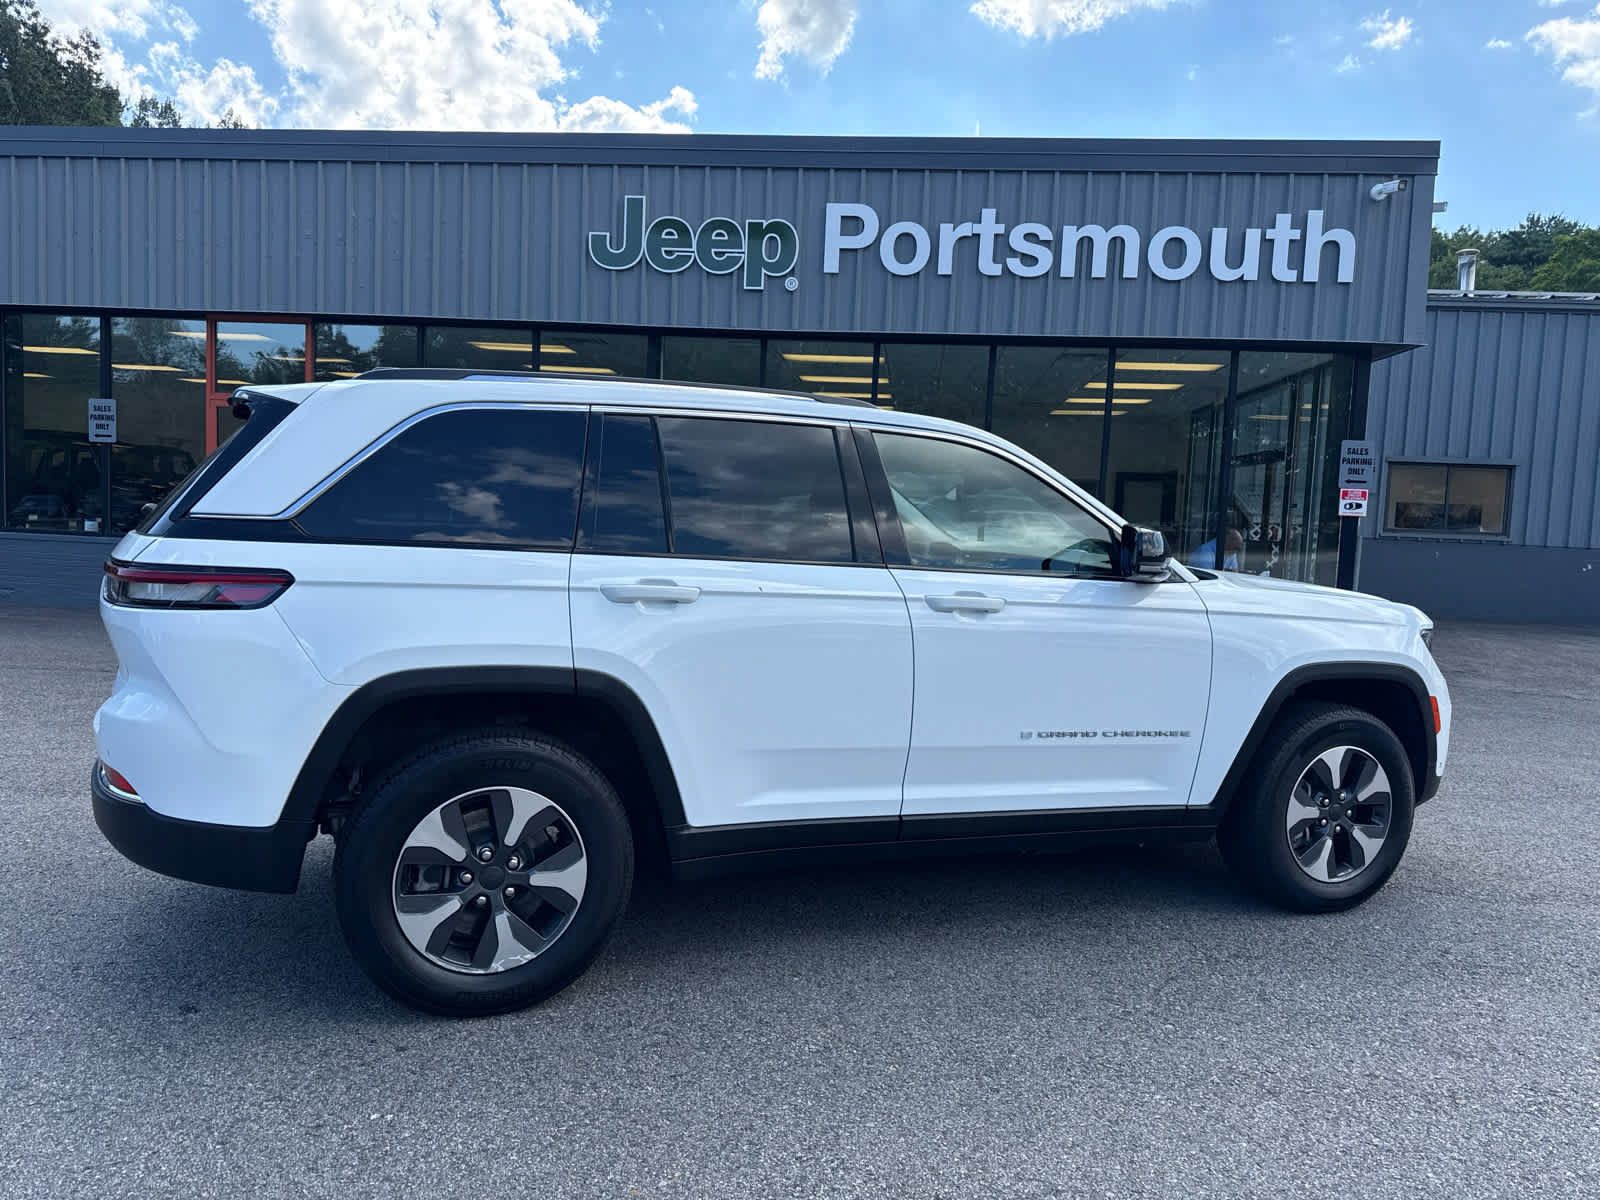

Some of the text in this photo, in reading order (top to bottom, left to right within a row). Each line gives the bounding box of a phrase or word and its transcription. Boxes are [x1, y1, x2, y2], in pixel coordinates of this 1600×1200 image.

[588, 195, 1356, 290] Jeep Portsmouth
[1342, 457, 1372, 465] PARKING
